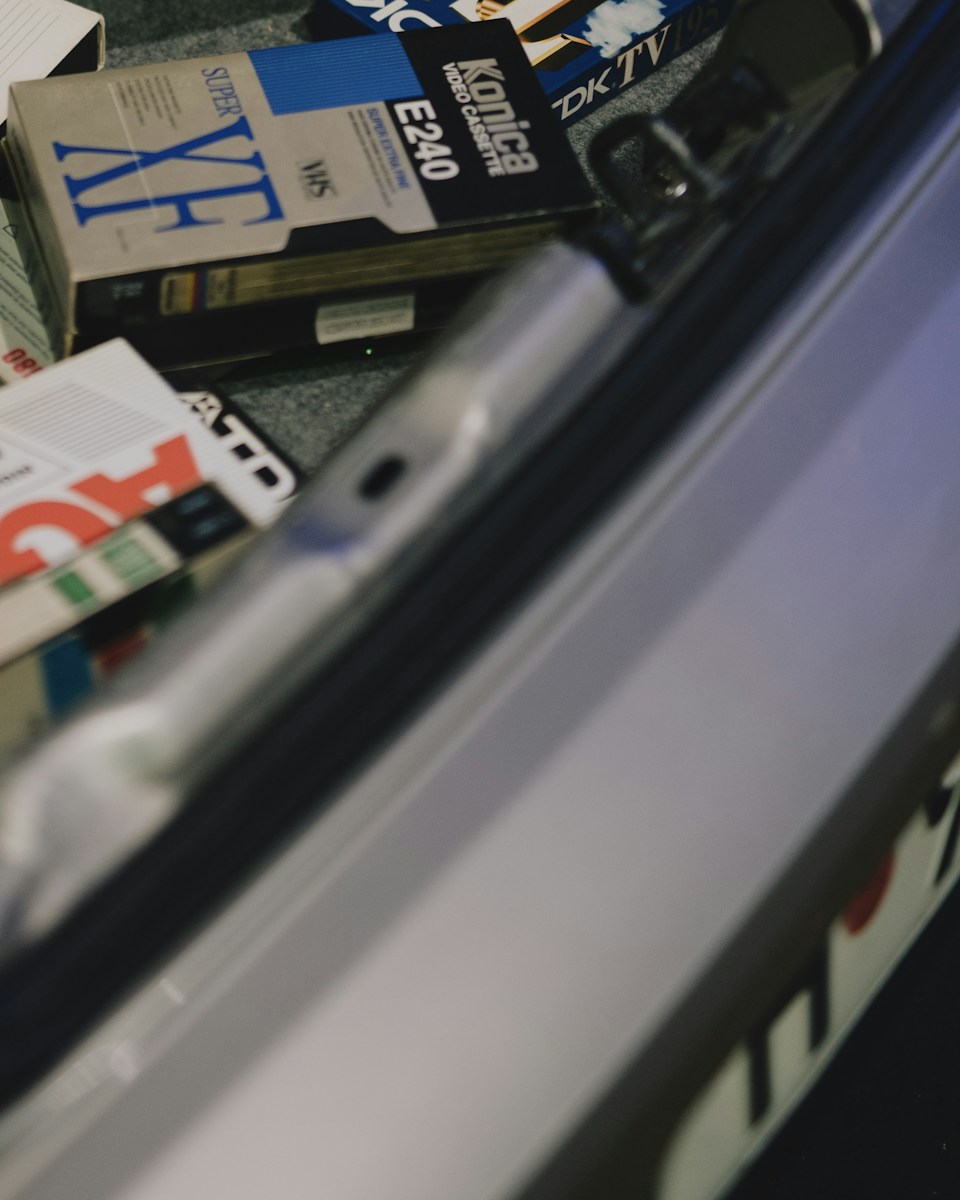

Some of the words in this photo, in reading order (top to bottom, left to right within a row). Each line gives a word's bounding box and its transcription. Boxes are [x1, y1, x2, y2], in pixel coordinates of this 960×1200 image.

[200, 66, 245, 119] SUPER
[616, 23, 671, 89] TV
[392, 99, 461, 182] E240
[441, 61, 473, 104] VIDEO
[460, 104, 507, 178] CASSETTE
[455, 56, 540, 176] Konica
[51, 114, 286, 234] XF
[300, 158, 337, 200] VHS
